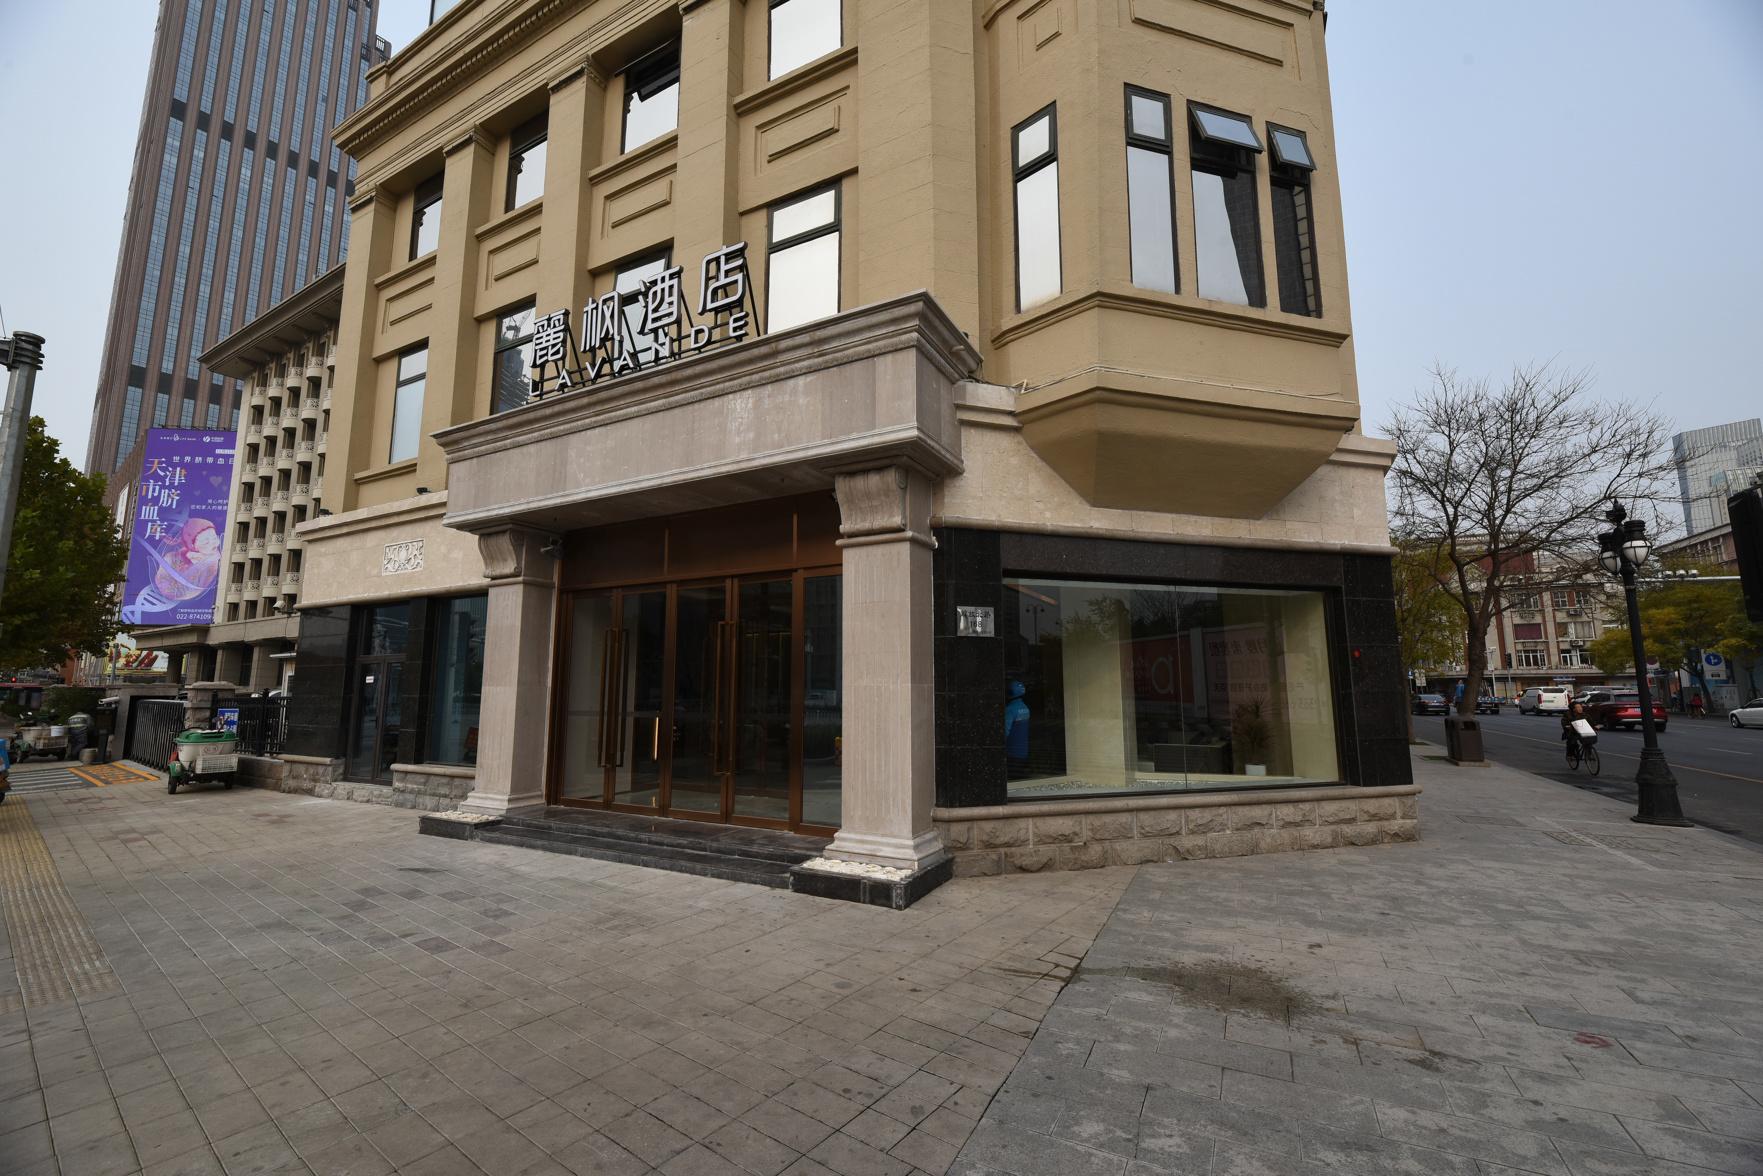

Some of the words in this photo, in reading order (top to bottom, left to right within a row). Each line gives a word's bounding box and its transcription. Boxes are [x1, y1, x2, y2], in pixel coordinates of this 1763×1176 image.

[529, 311, 749, 396] LAVANDE
[139, 457, 188, 540] 天津市脐血库
